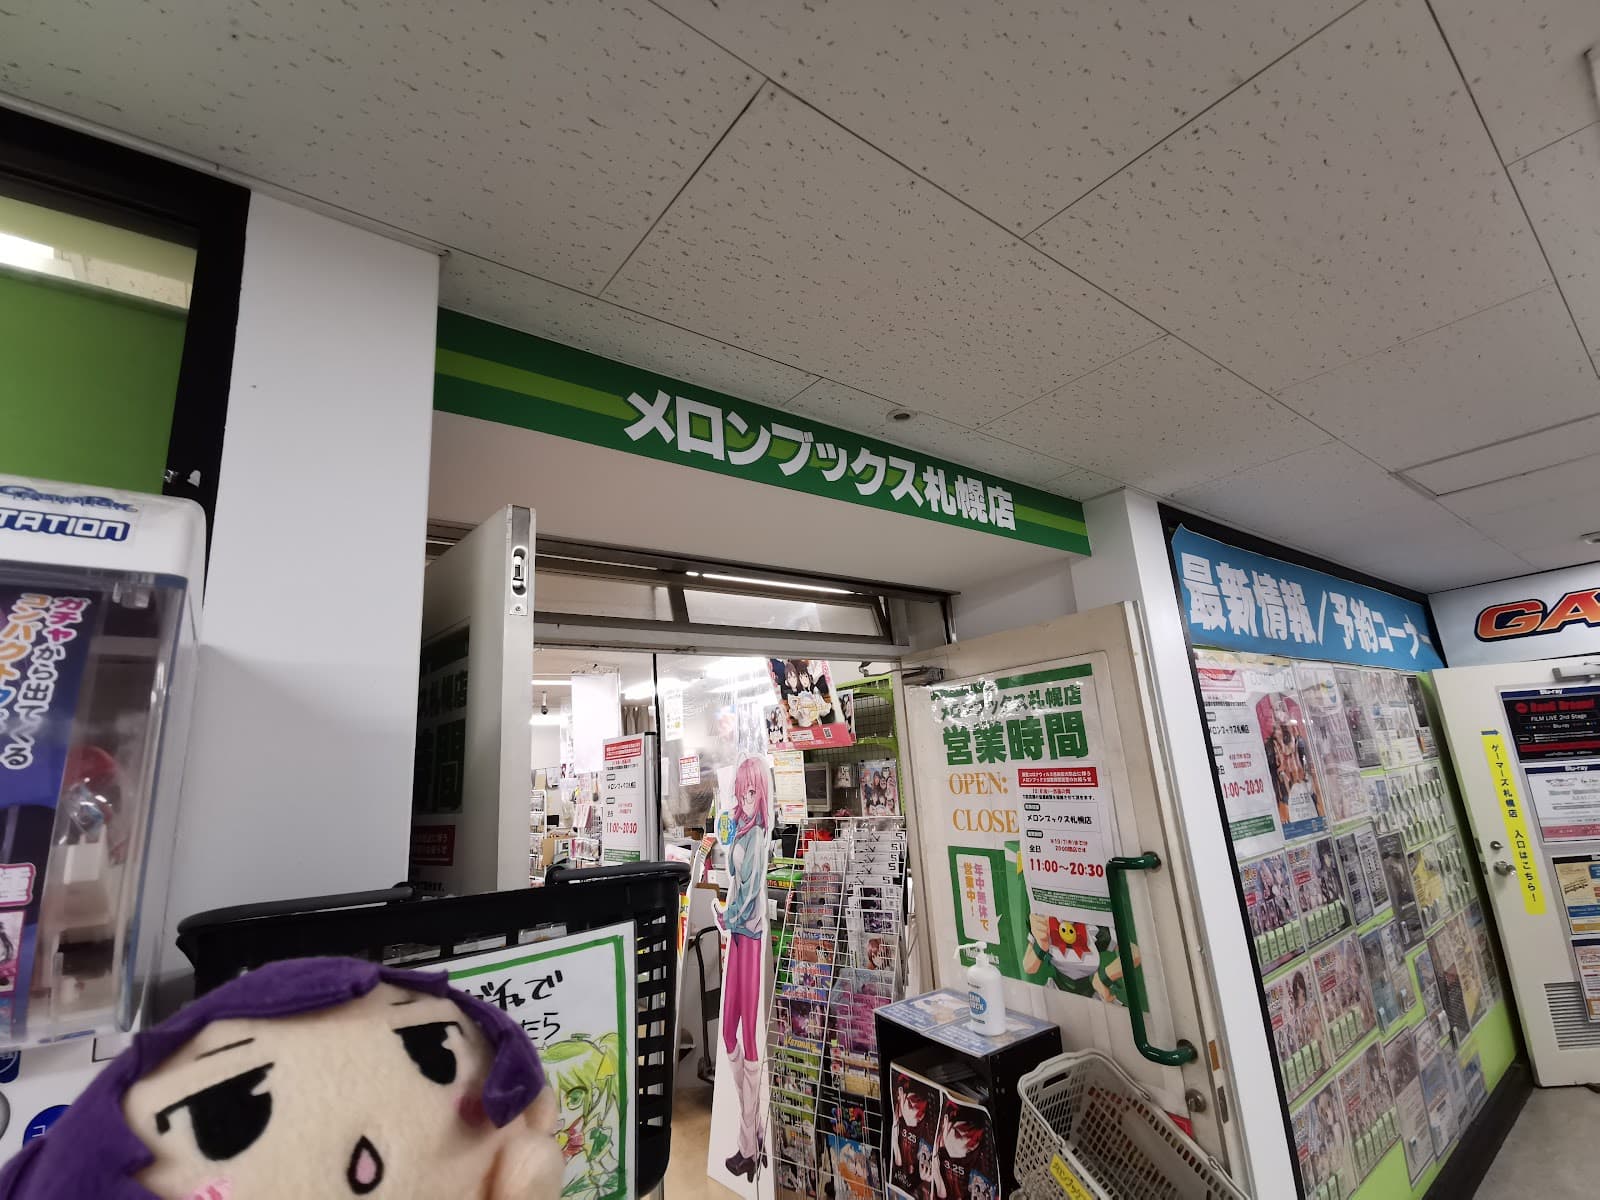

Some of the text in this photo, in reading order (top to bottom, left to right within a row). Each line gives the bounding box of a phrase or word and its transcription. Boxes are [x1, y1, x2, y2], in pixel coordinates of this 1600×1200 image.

[622, 389, 1017, 531] メロンブックス札幌店
[1475, 587, 1600, 641] GA
[942, 710, 1089, 766] 営業時間
[949, 770, 1010, 796] OPEN:
[1491, 743, 1518, 818] ゲーマーズ札幌店
[1027, 814, 1093, 825] メロンブックス札幌店
[464, 969, 563, 1012] チャで
